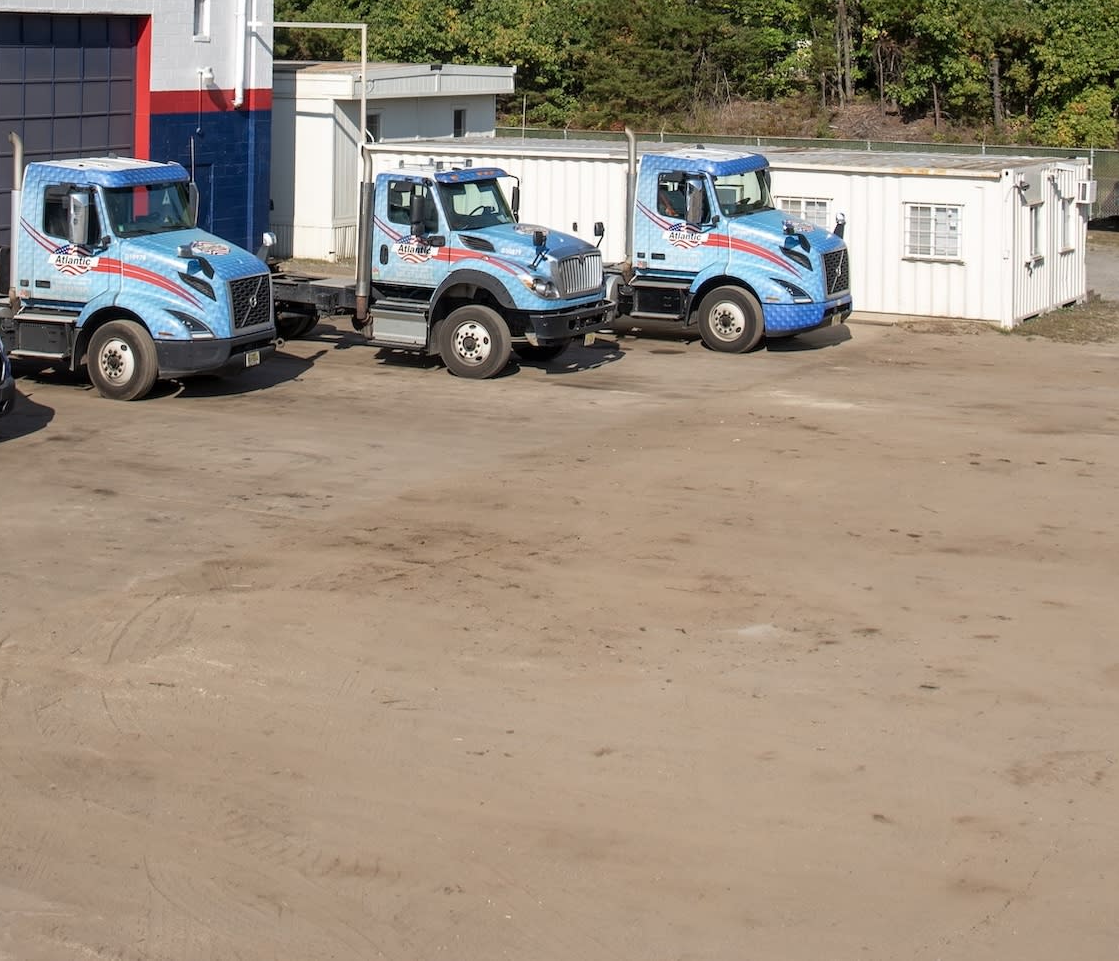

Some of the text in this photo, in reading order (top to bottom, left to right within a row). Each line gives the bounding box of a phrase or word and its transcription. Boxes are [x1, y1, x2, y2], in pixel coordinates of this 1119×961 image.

[669, 232, 701, 241] Atlantic
[398, 244, 431, 255] Atlantic
[55, 255, 91, 266] Atlantic
